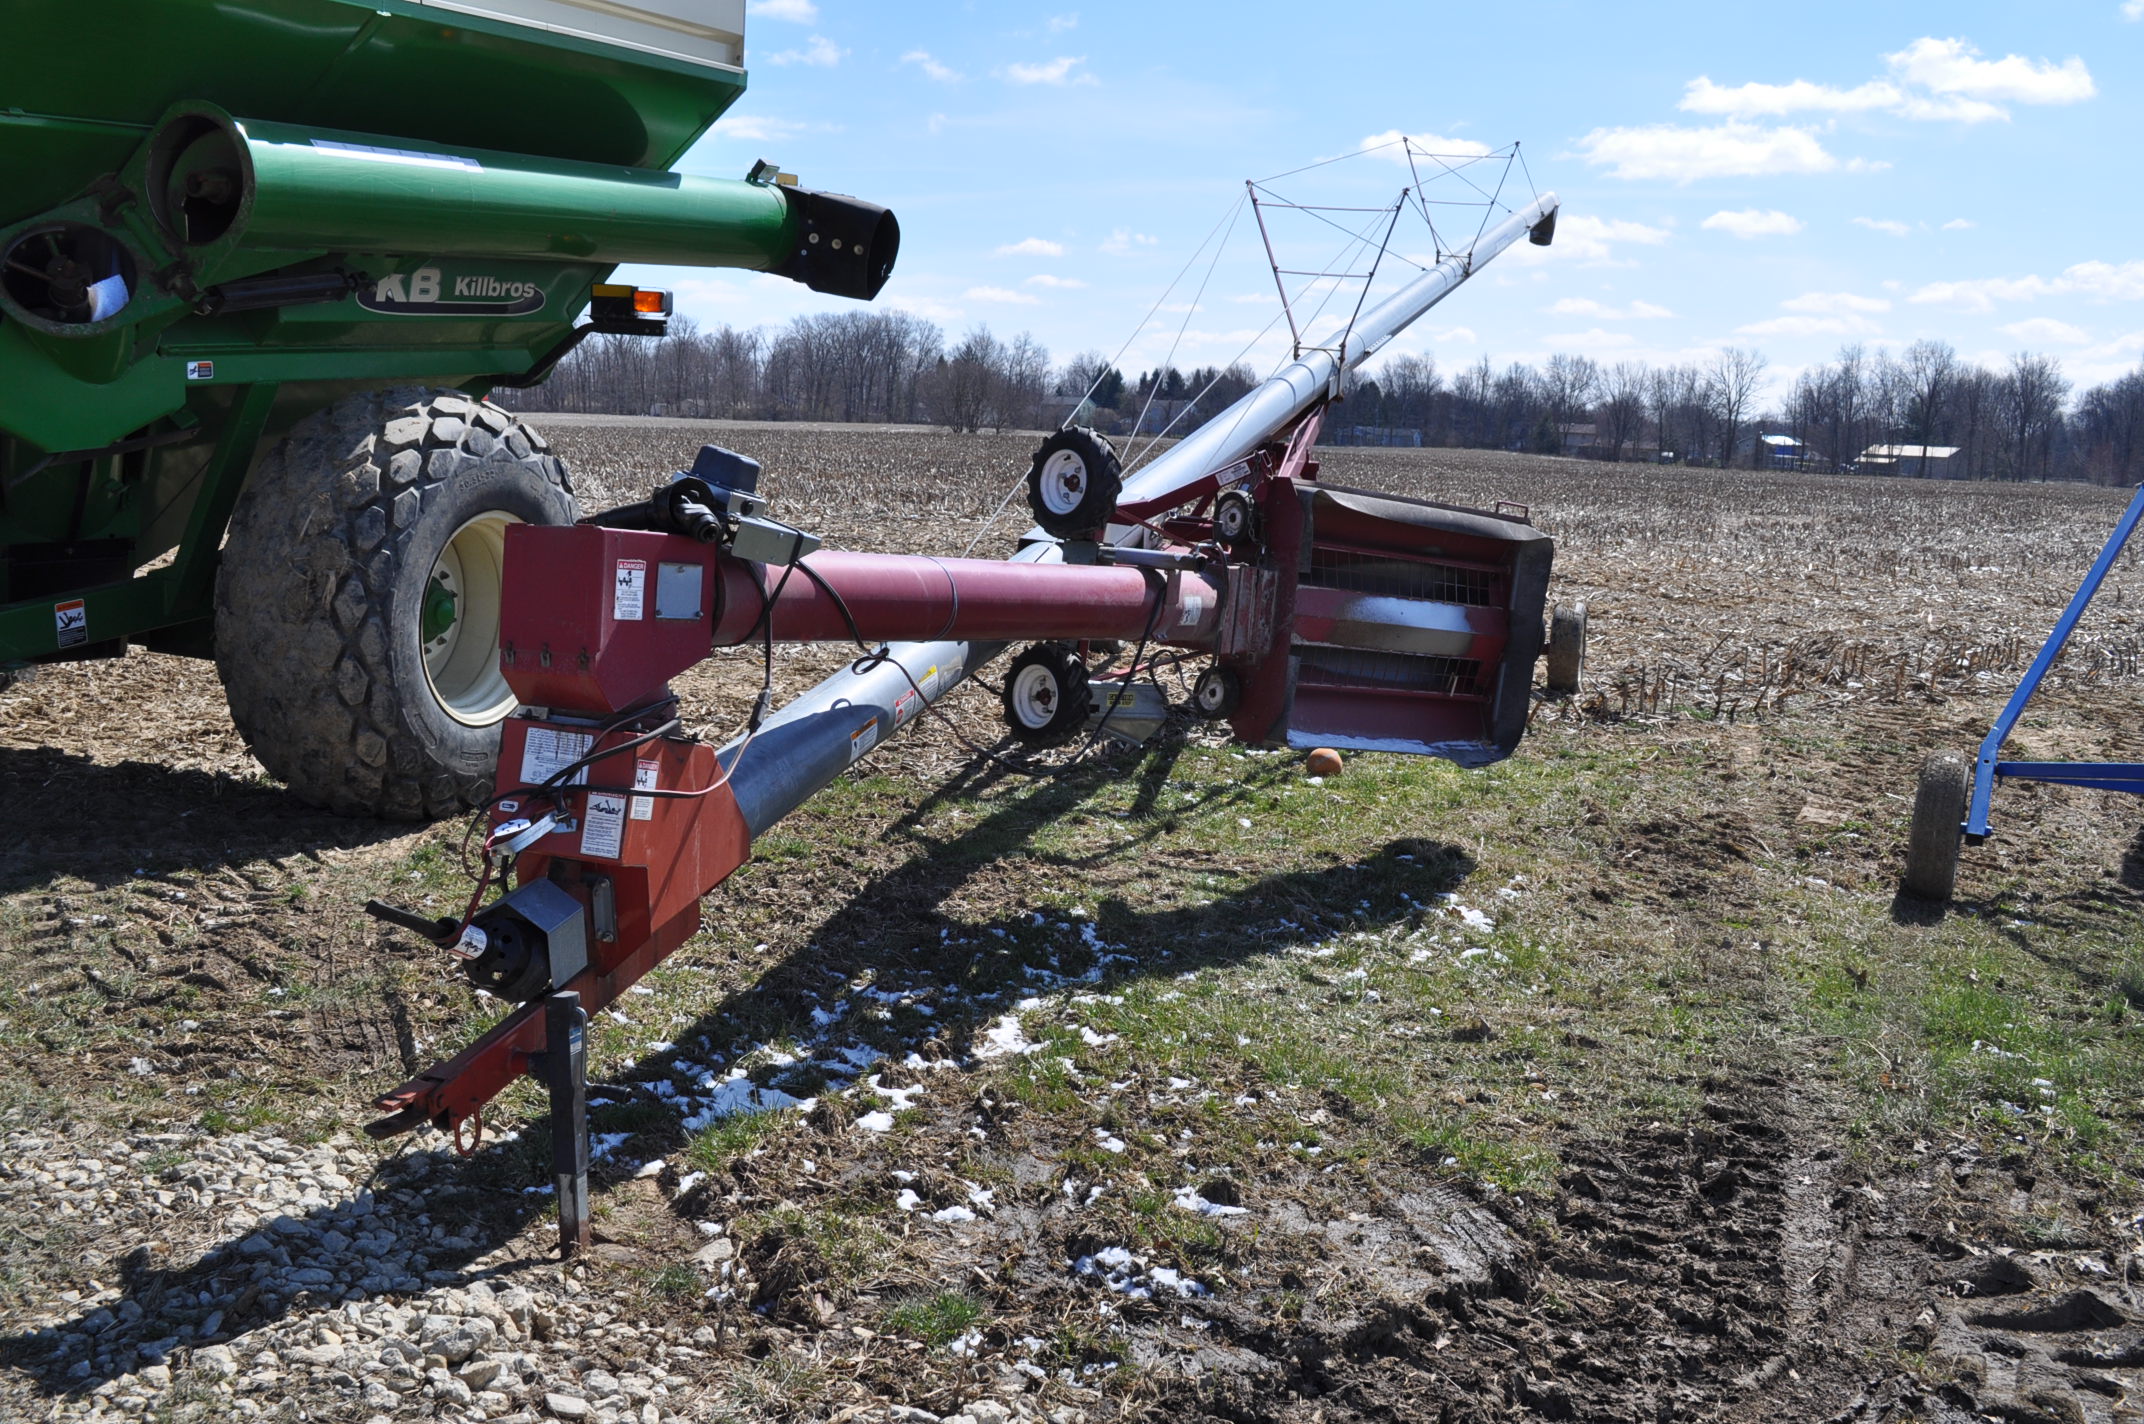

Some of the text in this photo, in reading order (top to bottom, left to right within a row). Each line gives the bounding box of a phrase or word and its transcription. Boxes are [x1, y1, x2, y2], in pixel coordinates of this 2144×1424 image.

[375, 267, 536, 303] KB Killbros
[623, 562, 644, 570] DANGER
